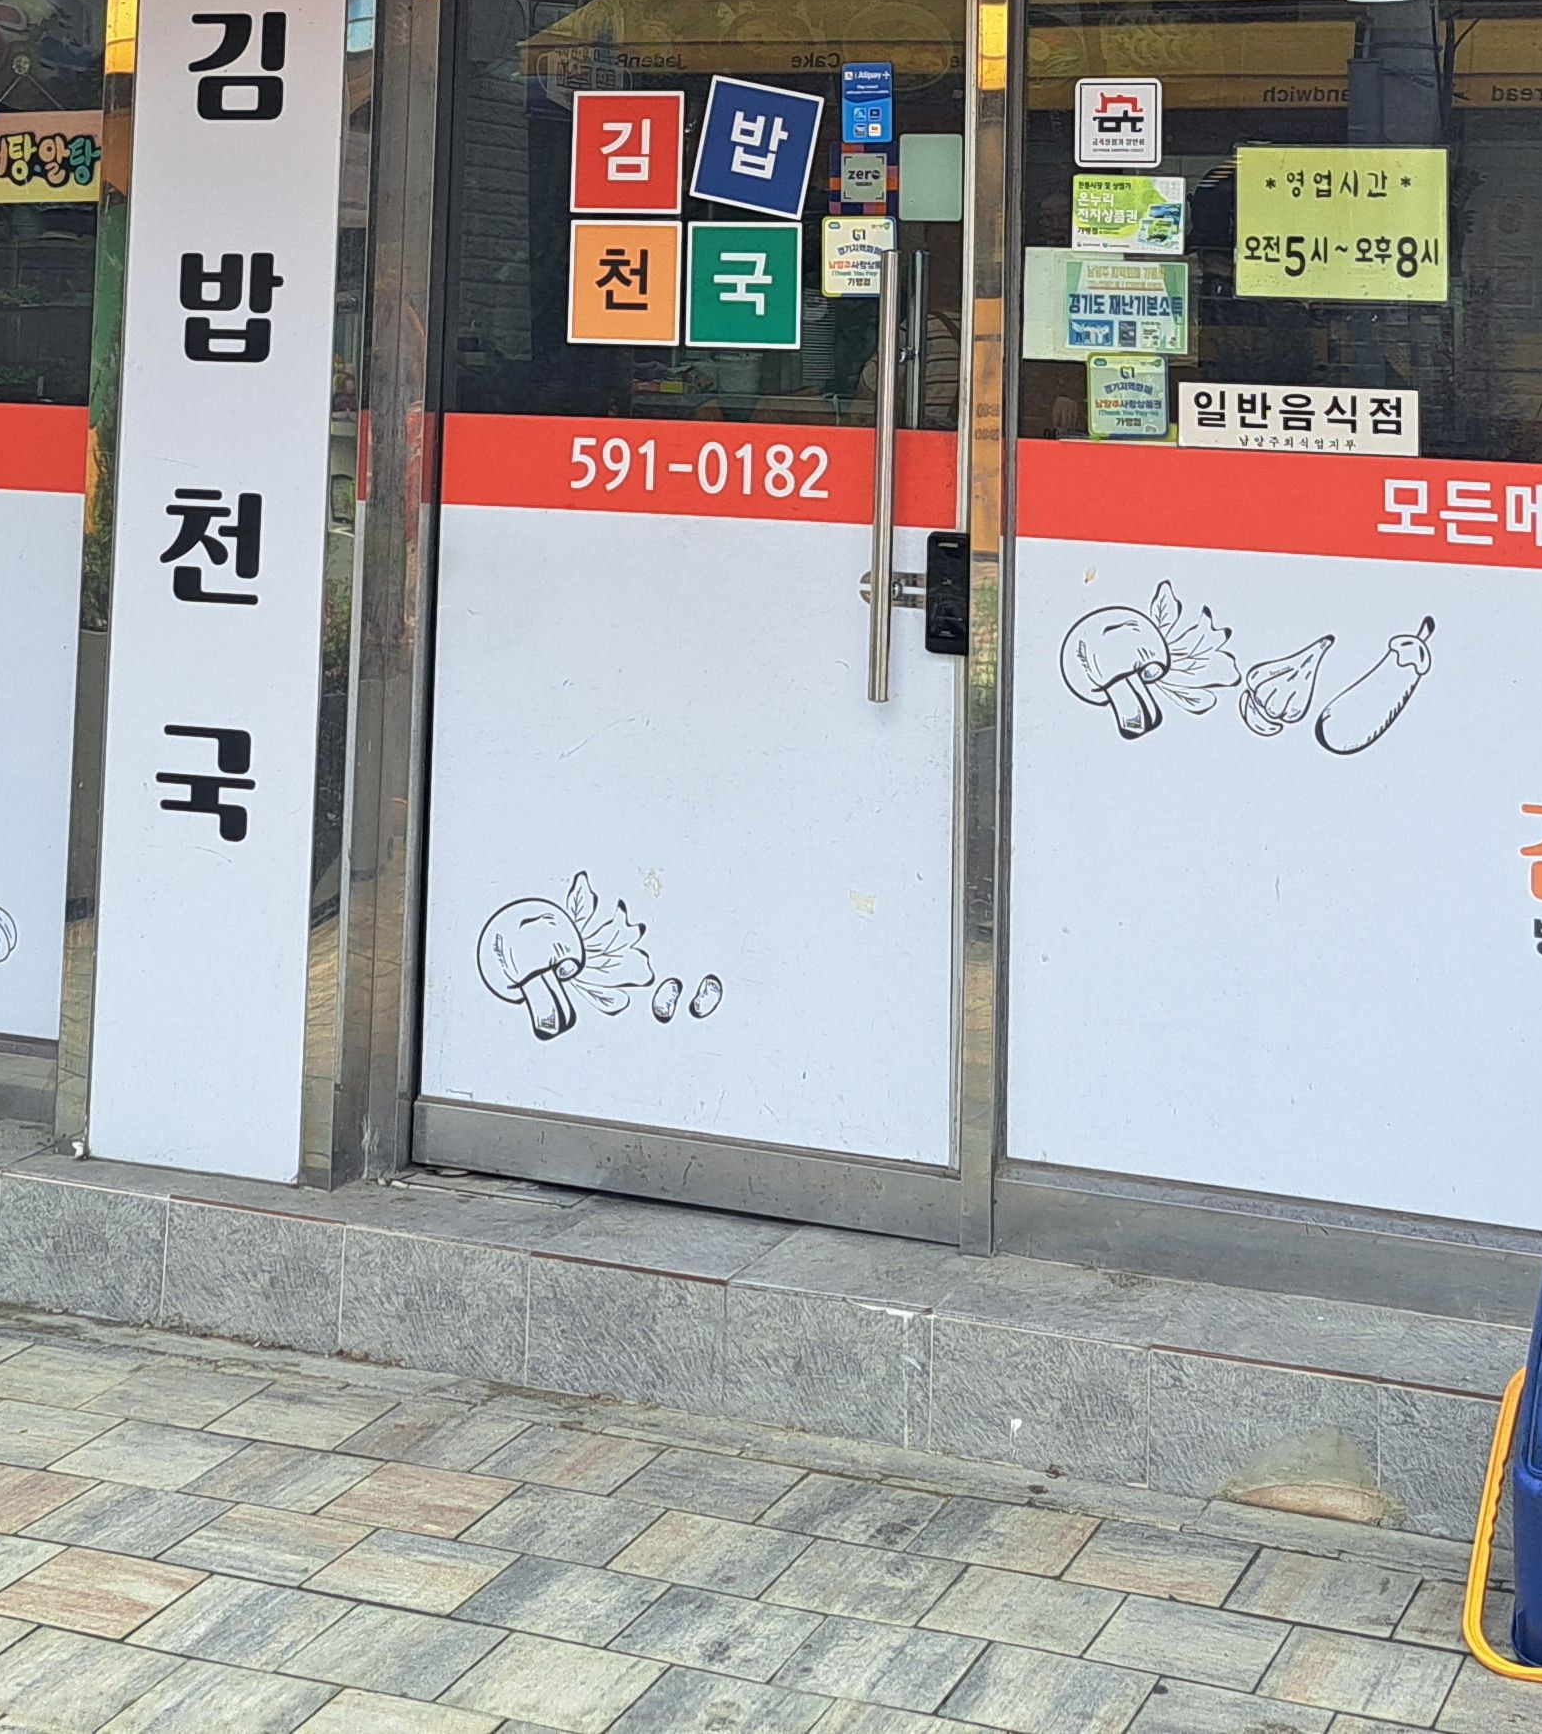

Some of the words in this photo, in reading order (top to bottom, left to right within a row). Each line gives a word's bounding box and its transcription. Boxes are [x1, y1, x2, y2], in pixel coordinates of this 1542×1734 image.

[601, 117, 652, 183] 김
[729, 111, 790, 182] 밥
[1077, 192, 1115, 207] 온누리
[1286, 169, 1390, 198] 영업시간
[1077, 207, 1139, 225] 전자상품권
[594, 247, 651, 312] 천
[712, 250, 773, 317] 국
[1068, 293, 1107, 315] 경기도
[1108, 294, 1184, 318] 재난기본소득
[155, 9, 290, 843] 김밥천국
[1192, 390, 1404, 435] 일반음식점
[568, 436, 831, 501] 591-0182
